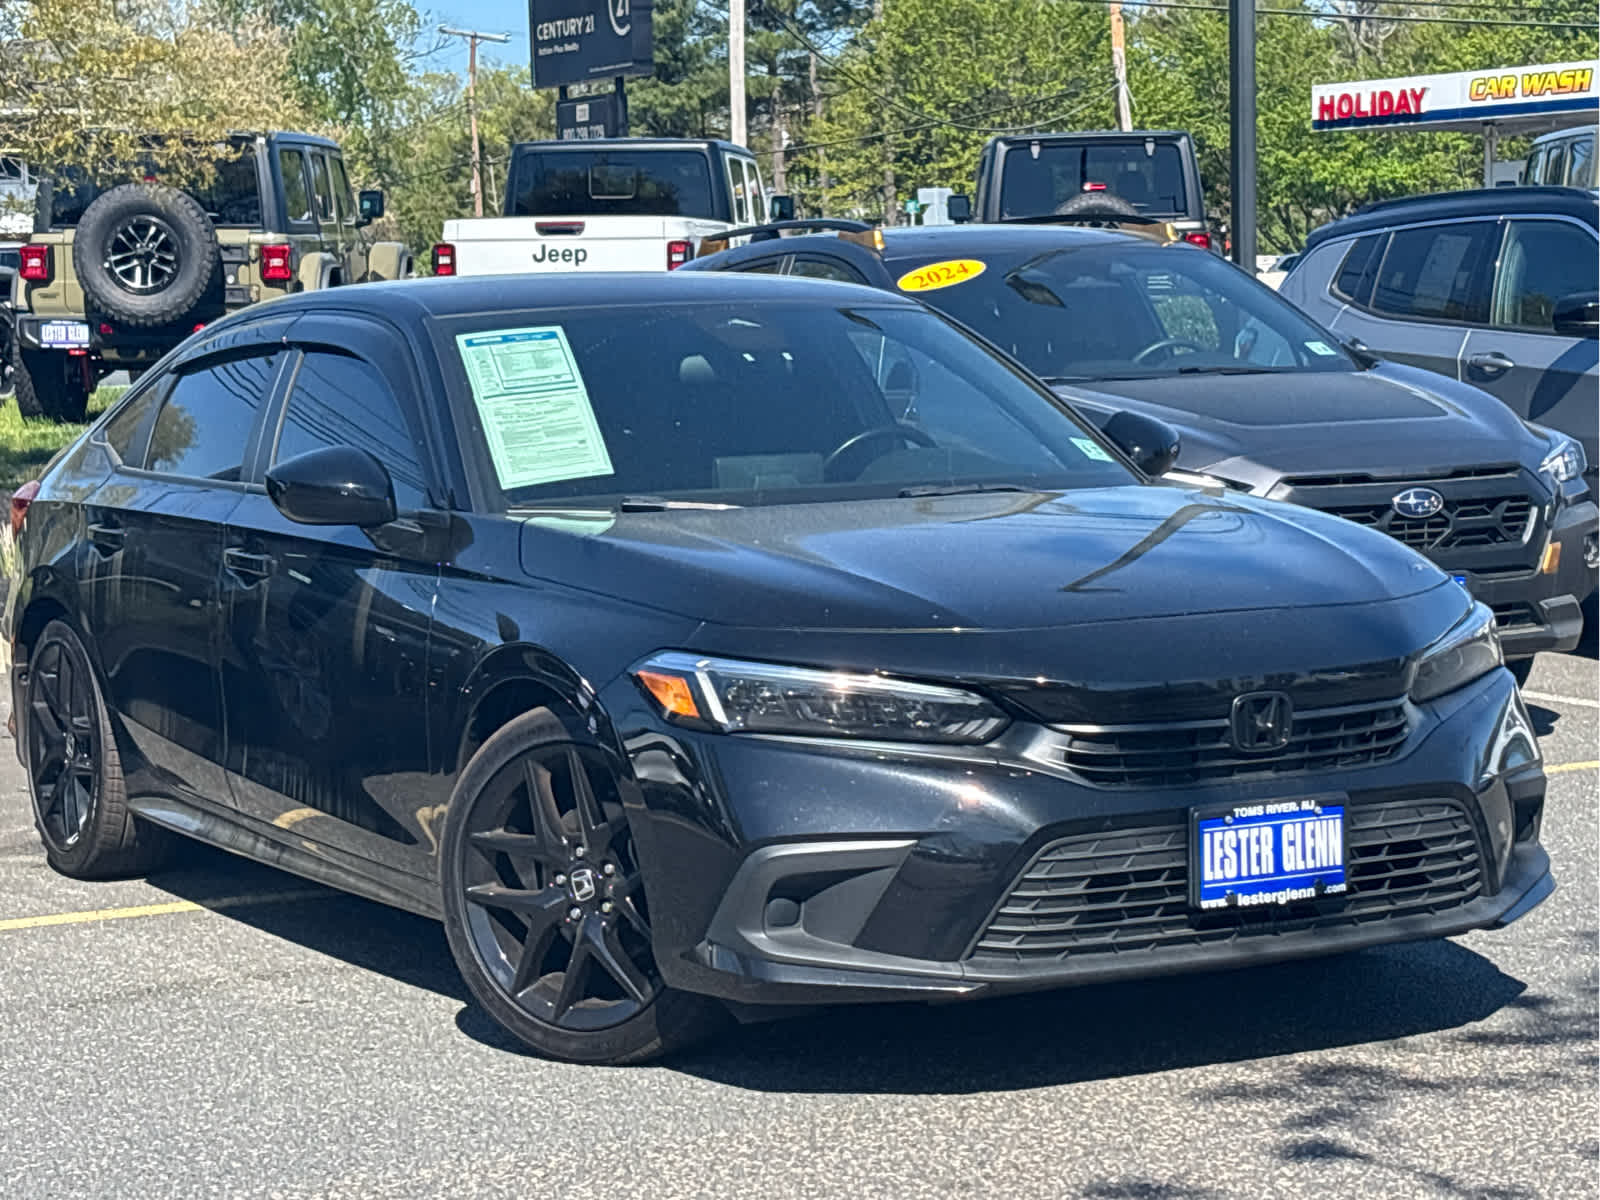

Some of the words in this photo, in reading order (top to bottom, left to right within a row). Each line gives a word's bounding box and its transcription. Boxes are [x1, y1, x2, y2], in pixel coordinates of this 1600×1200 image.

[536, 16, 583, 41] CENTURY
[584, 14, 595, 33] 21
[1319, 87, 1428, 121] HOLIDAY
[1469, 75, 1518, 101] CAR
[1521, 68, 1594, 97] WASH
[532, 244, 588, 266] Jeep
[912, 263, 969, 288] 2024
[1233, 804, 1265, 818] TOMS
[1301, 800, 1316, 811] NJ
[1203, 826, 1275, 881] LESTER
[1281, 818, 1343, 872] GLENN
[1237, 887, 1316, 906] lesterglenn
